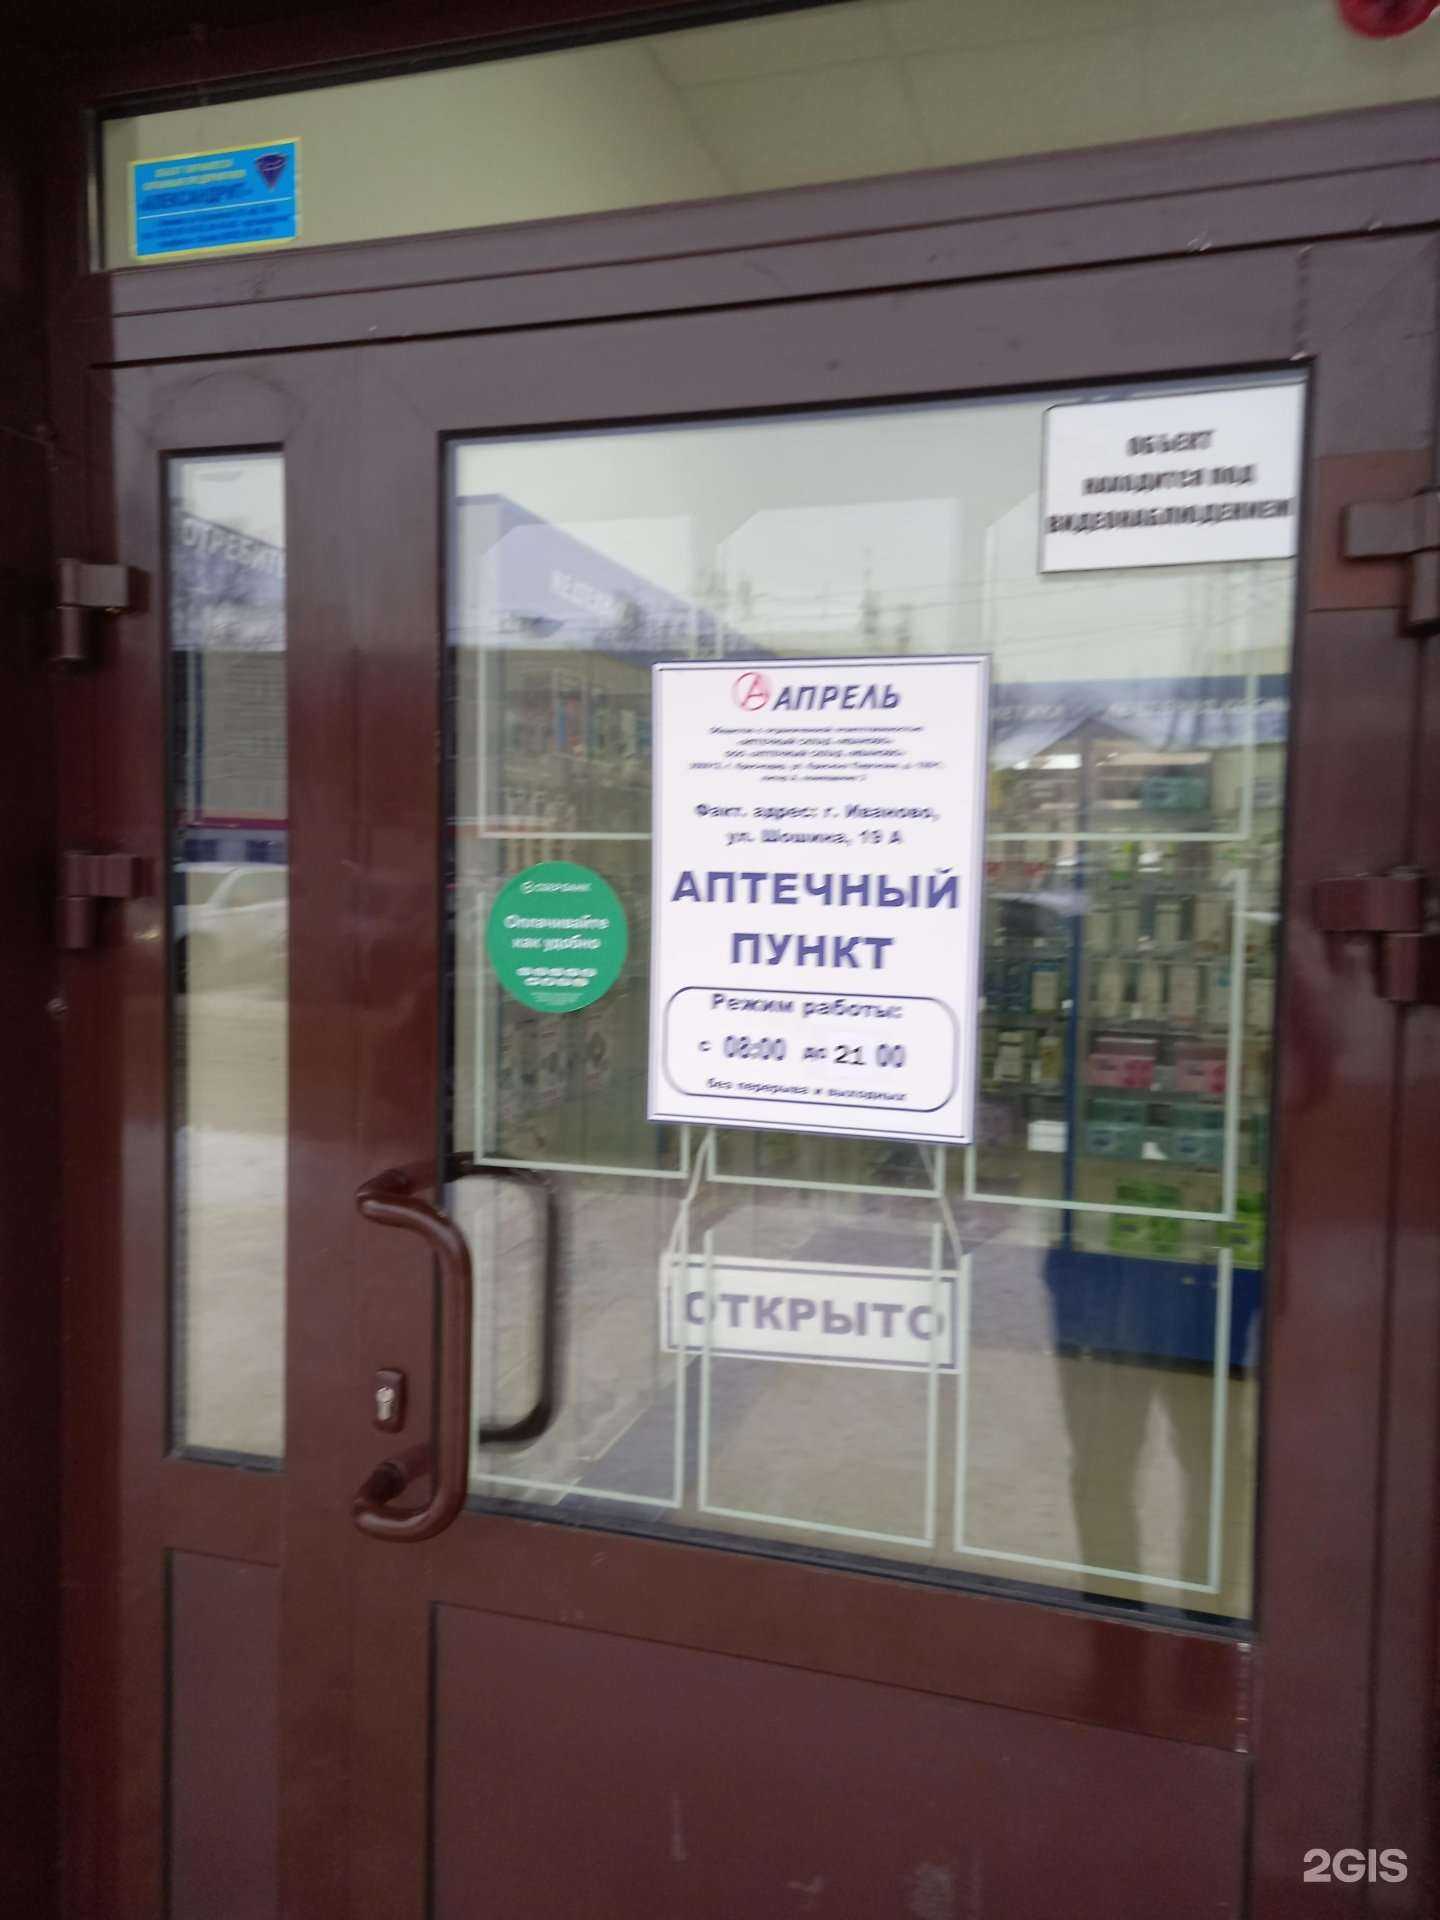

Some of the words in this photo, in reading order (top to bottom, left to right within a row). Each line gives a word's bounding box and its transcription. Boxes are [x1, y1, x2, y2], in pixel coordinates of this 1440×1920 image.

[1126, 429, 1216, 456] ОБЪЕКТ
[1082, 468, 1201, 496] НАХОДИТСЯ
[1210, 463, 1258, 486] ПОД
[1046, 498, 1297, 534] ВИДЕОНАБЛЮДЕНИЕМ
[772, 684, 900, 711] АПРЕЛЬ
[671, 866, 960, 909] АПТЕЧНЫЙ
[730, 932, 895, 969] ПУНКТ
[711, 993, 796, 1014] Режим
[802, 998, 903, 1019] работы:
[834, 1044, 867, 1066] 21
[685, 1291, 945, 1341] ОТКРЫТО
